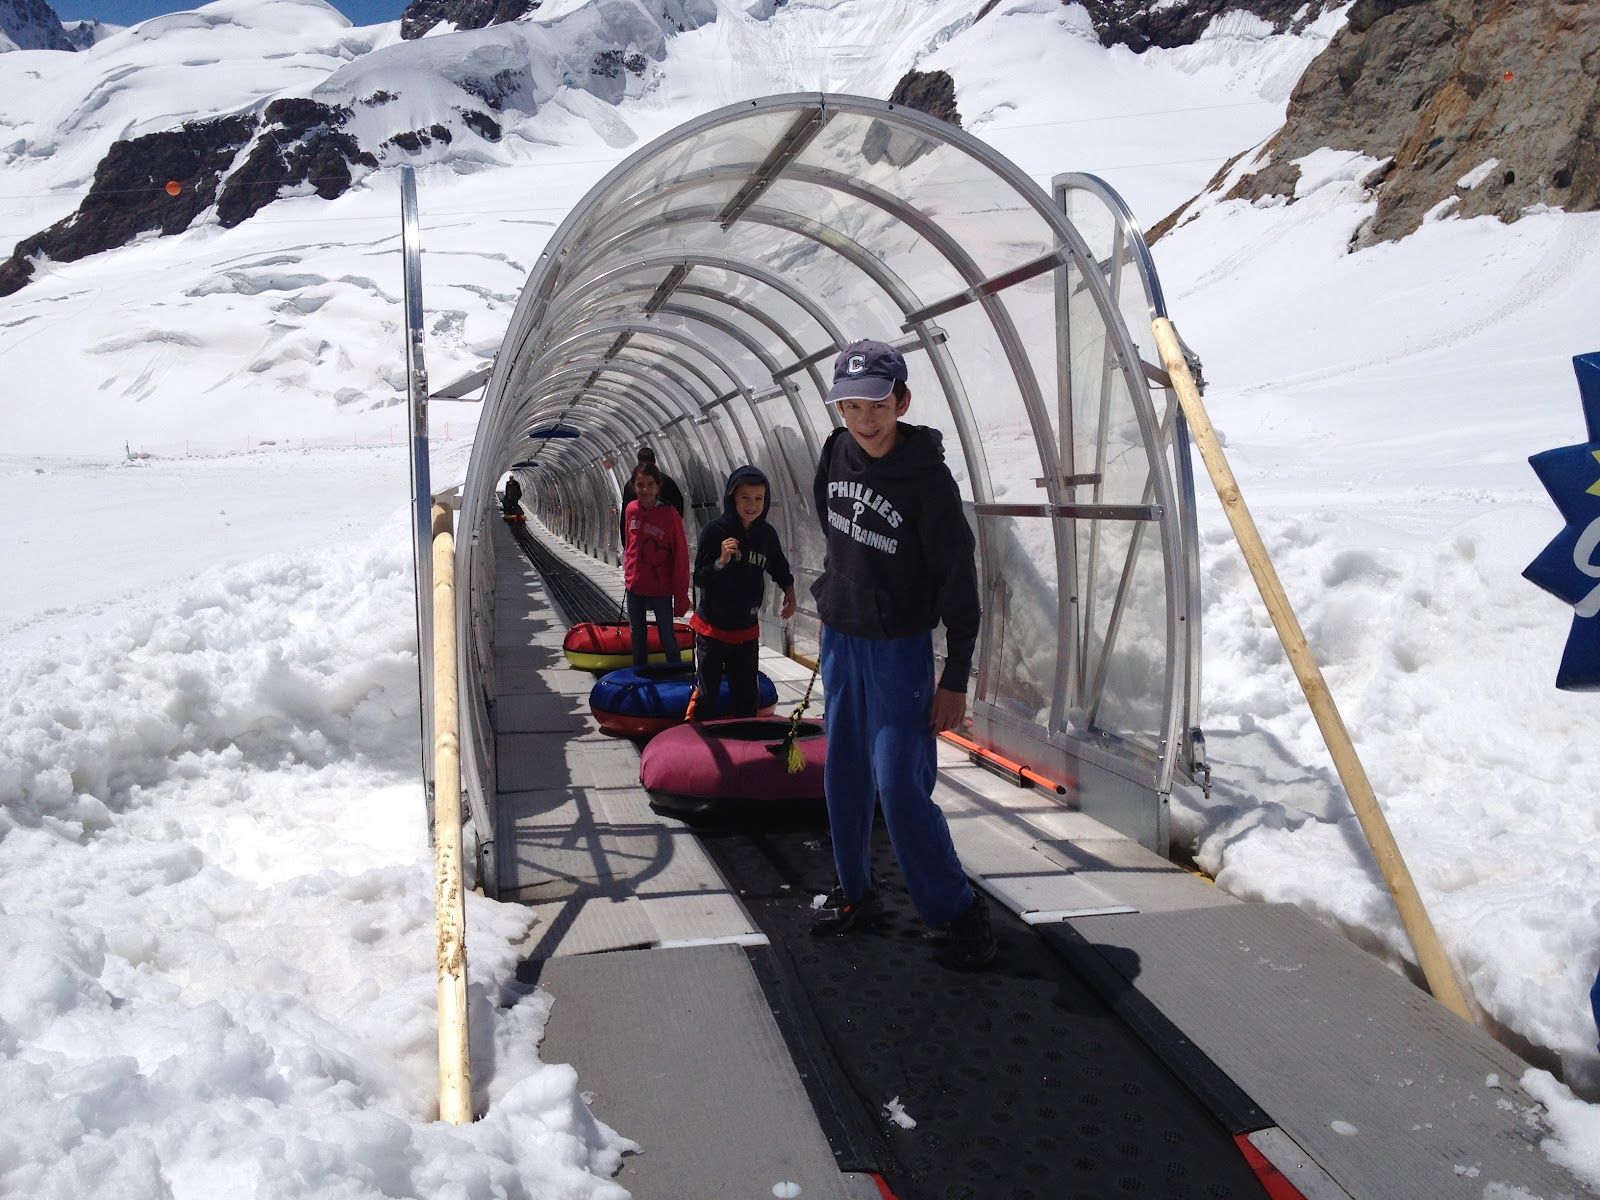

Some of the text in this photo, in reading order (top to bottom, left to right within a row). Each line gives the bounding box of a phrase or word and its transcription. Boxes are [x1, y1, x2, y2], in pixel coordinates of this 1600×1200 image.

[847, 354, 865, 374] C
[828, 481, 903, 528] PHILLIES
[853, 501, 865, 522] P
[851, 522, 898, 554] TRAINING
